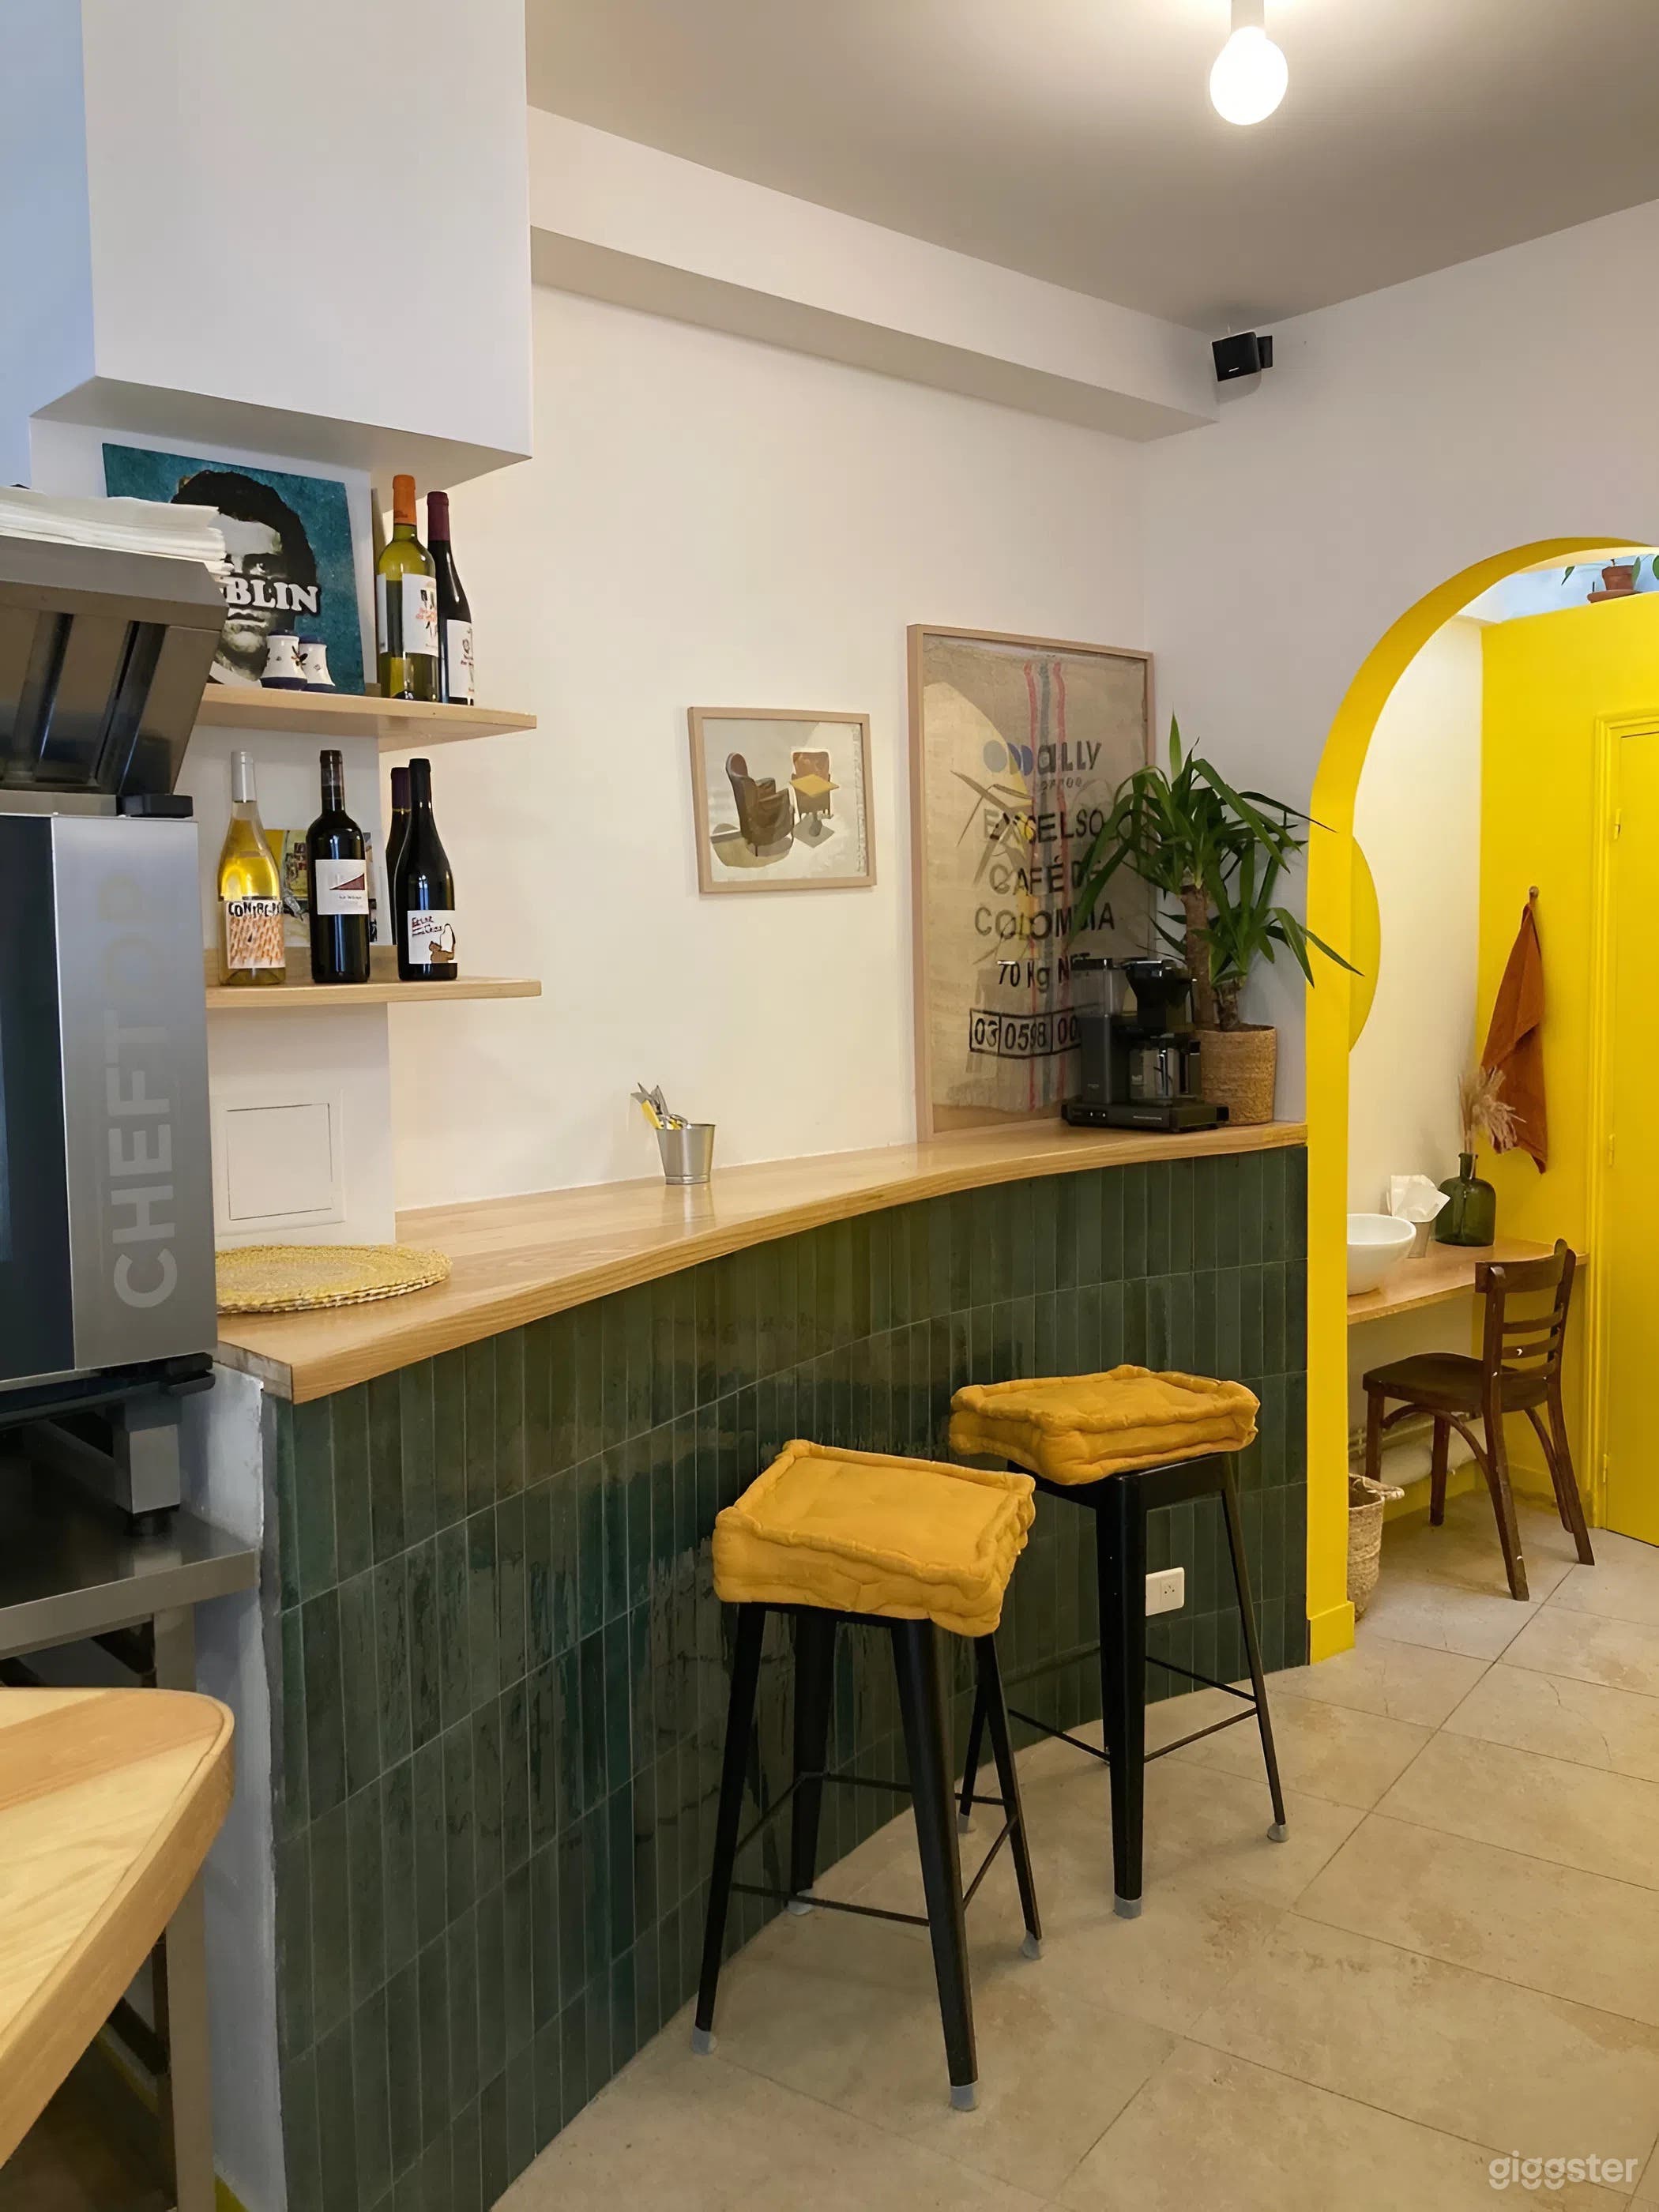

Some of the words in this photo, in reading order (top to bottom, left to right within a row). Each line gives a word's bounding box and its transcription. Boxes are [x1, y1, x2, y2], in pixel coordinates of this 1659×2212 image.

[220, 577, 318, 613] BLIN
[989, 855, 1064, 896] CAFÉ
[975, 902, 1115, 941] COLOMIA
[999, 961, 1021, 988] 70
